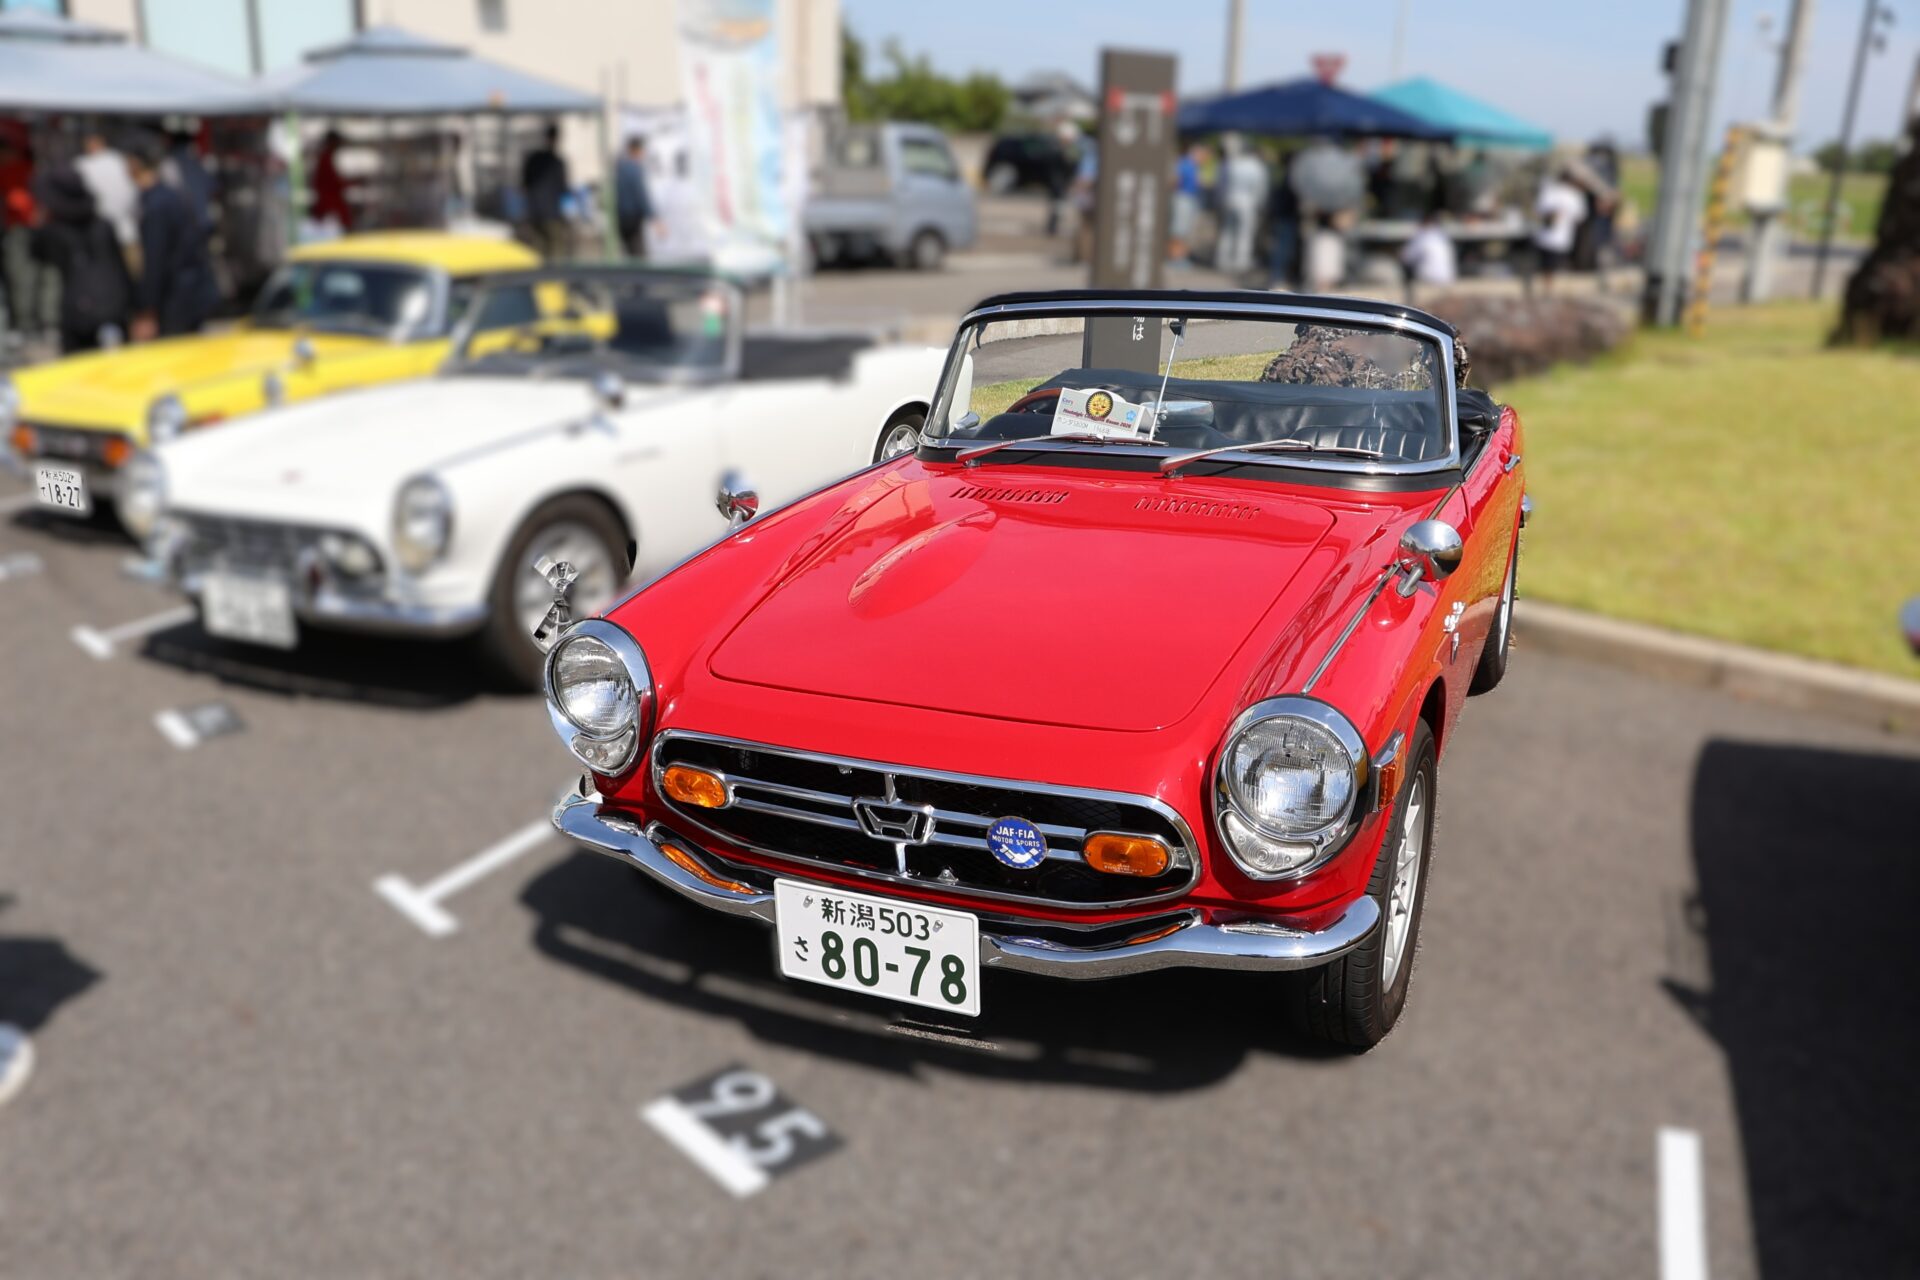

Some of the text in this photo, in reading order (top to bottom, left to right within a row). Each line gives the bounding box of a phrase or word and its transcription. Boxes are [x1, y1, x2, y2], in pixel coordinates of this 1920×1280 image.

[992, 835, 1040, 848] MOTOR SPORTS
[793, 930, 967, 1005] さ 80-78
